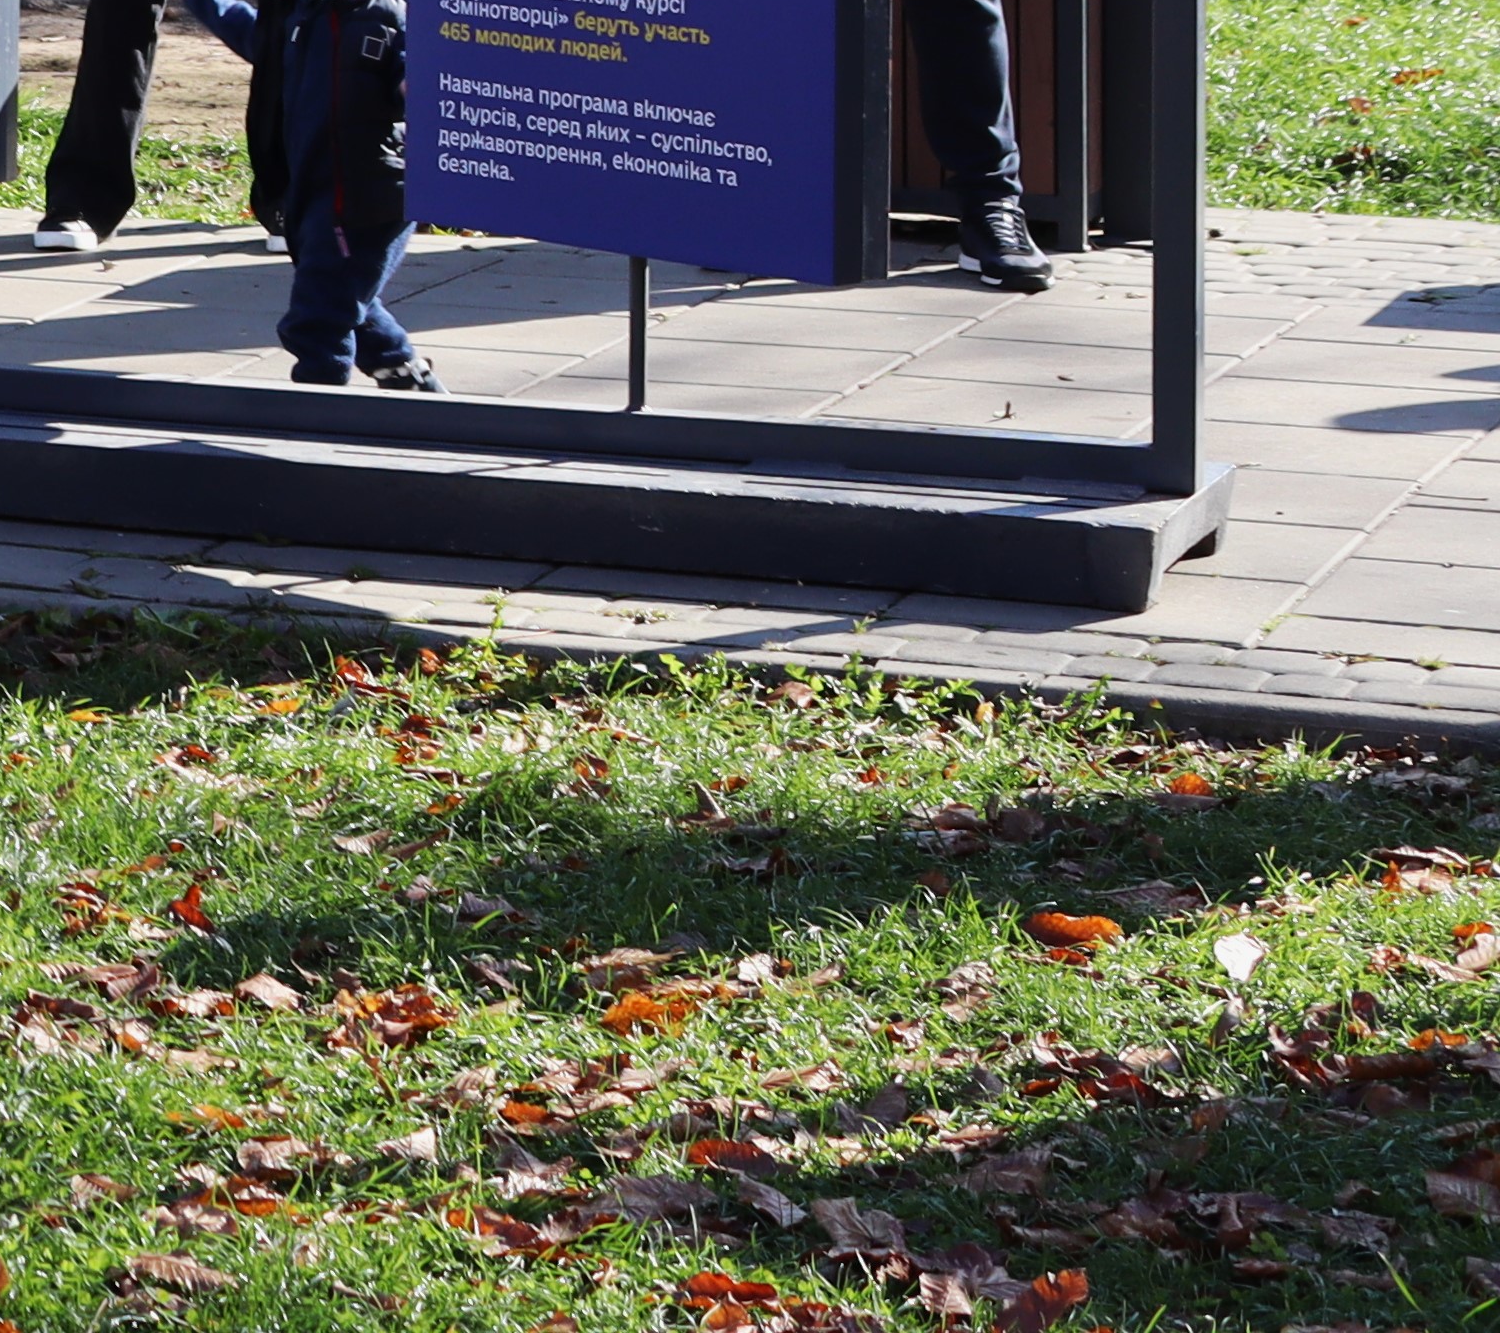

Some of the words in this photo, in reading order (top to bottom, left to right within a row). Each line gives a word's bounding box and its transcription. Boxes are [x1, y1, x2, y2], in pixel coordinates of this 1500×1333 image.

[439, 21, 471, 43] 465
[475, 28, 556, 54] молодих
[559, 39, 628, 63] людей.
[438, 99, 457, 120] 12
[460, 100, 522, 132] курсів,
[526, 114, 583, 141] серед
[585, 119, 631, 144] яких
[650, 131, 773, 167] суспільство,
